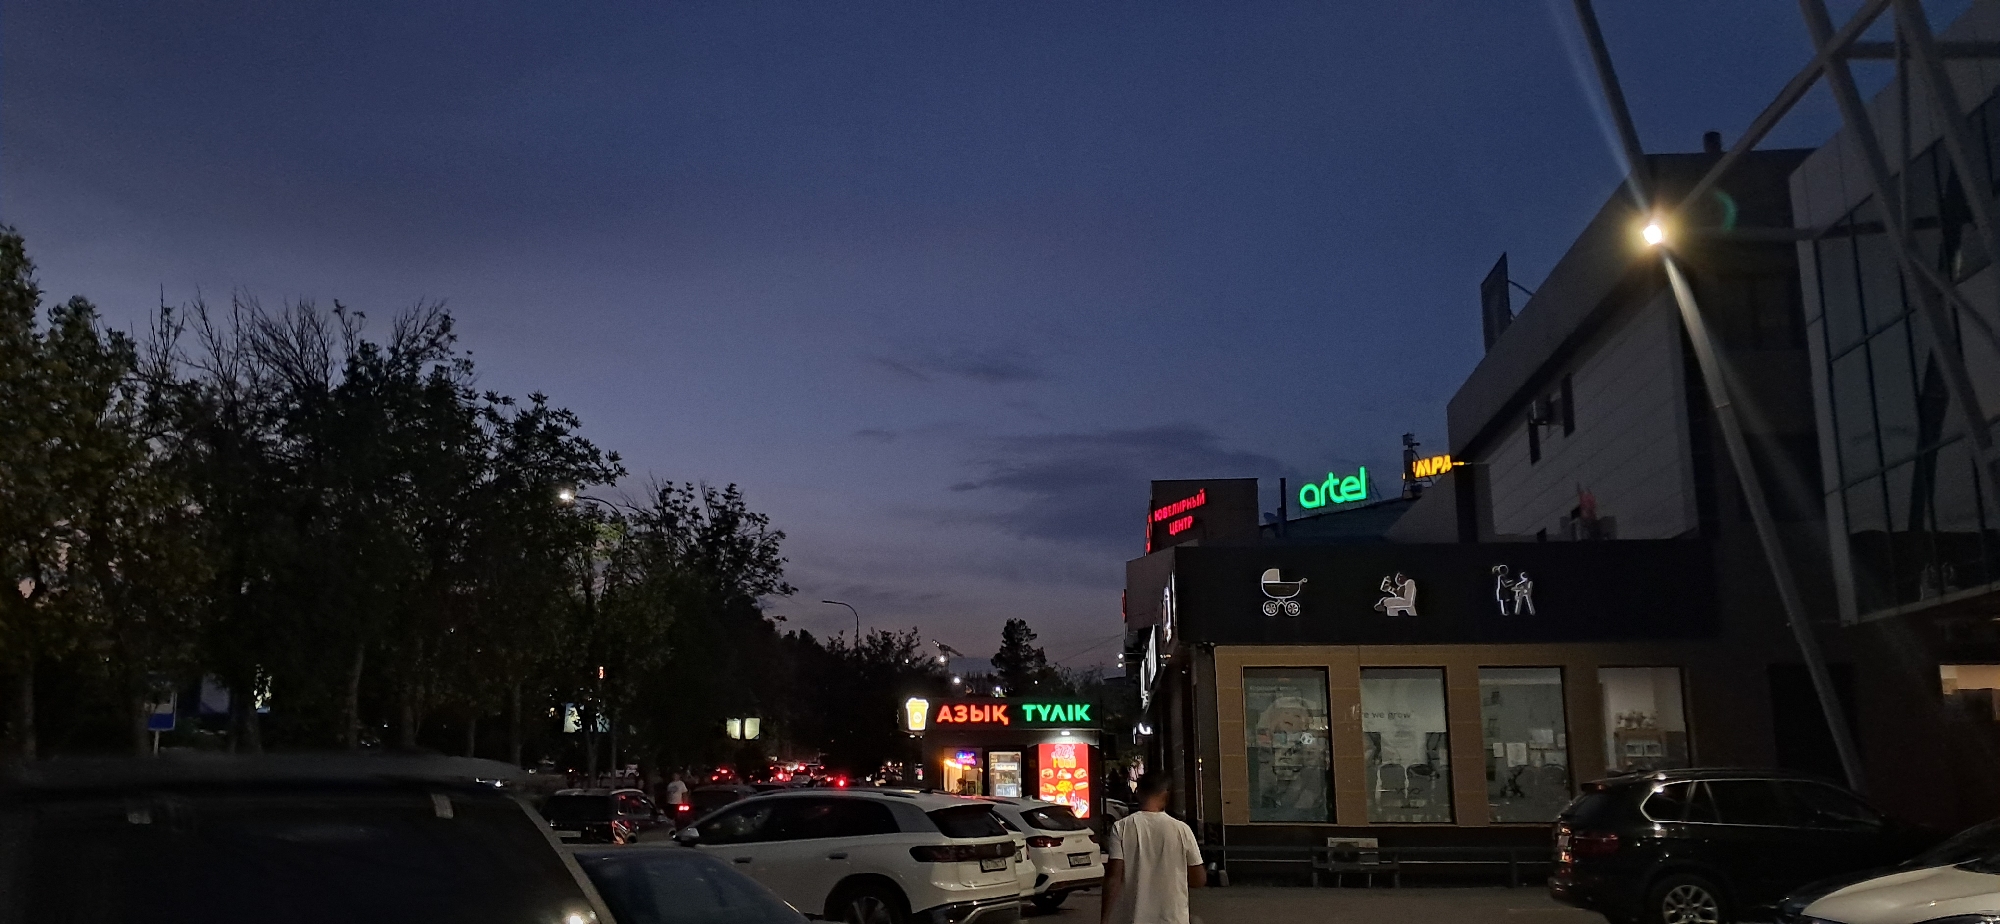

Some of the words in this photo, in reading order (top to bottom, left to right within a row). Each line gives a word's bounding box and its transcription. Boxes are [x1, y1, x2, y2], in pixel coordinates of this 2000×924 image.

[1299, 466, 1368, 509] artel
[1154, 488, 1206, 522] ЮВЕЛИРНЫЙ
[1169, 515, 1194, 536] ЦЕНТР
[936, 703, 1010, 726] АЗЫҚ
[1022, 703, 1091, 722] ТҮЛІК
